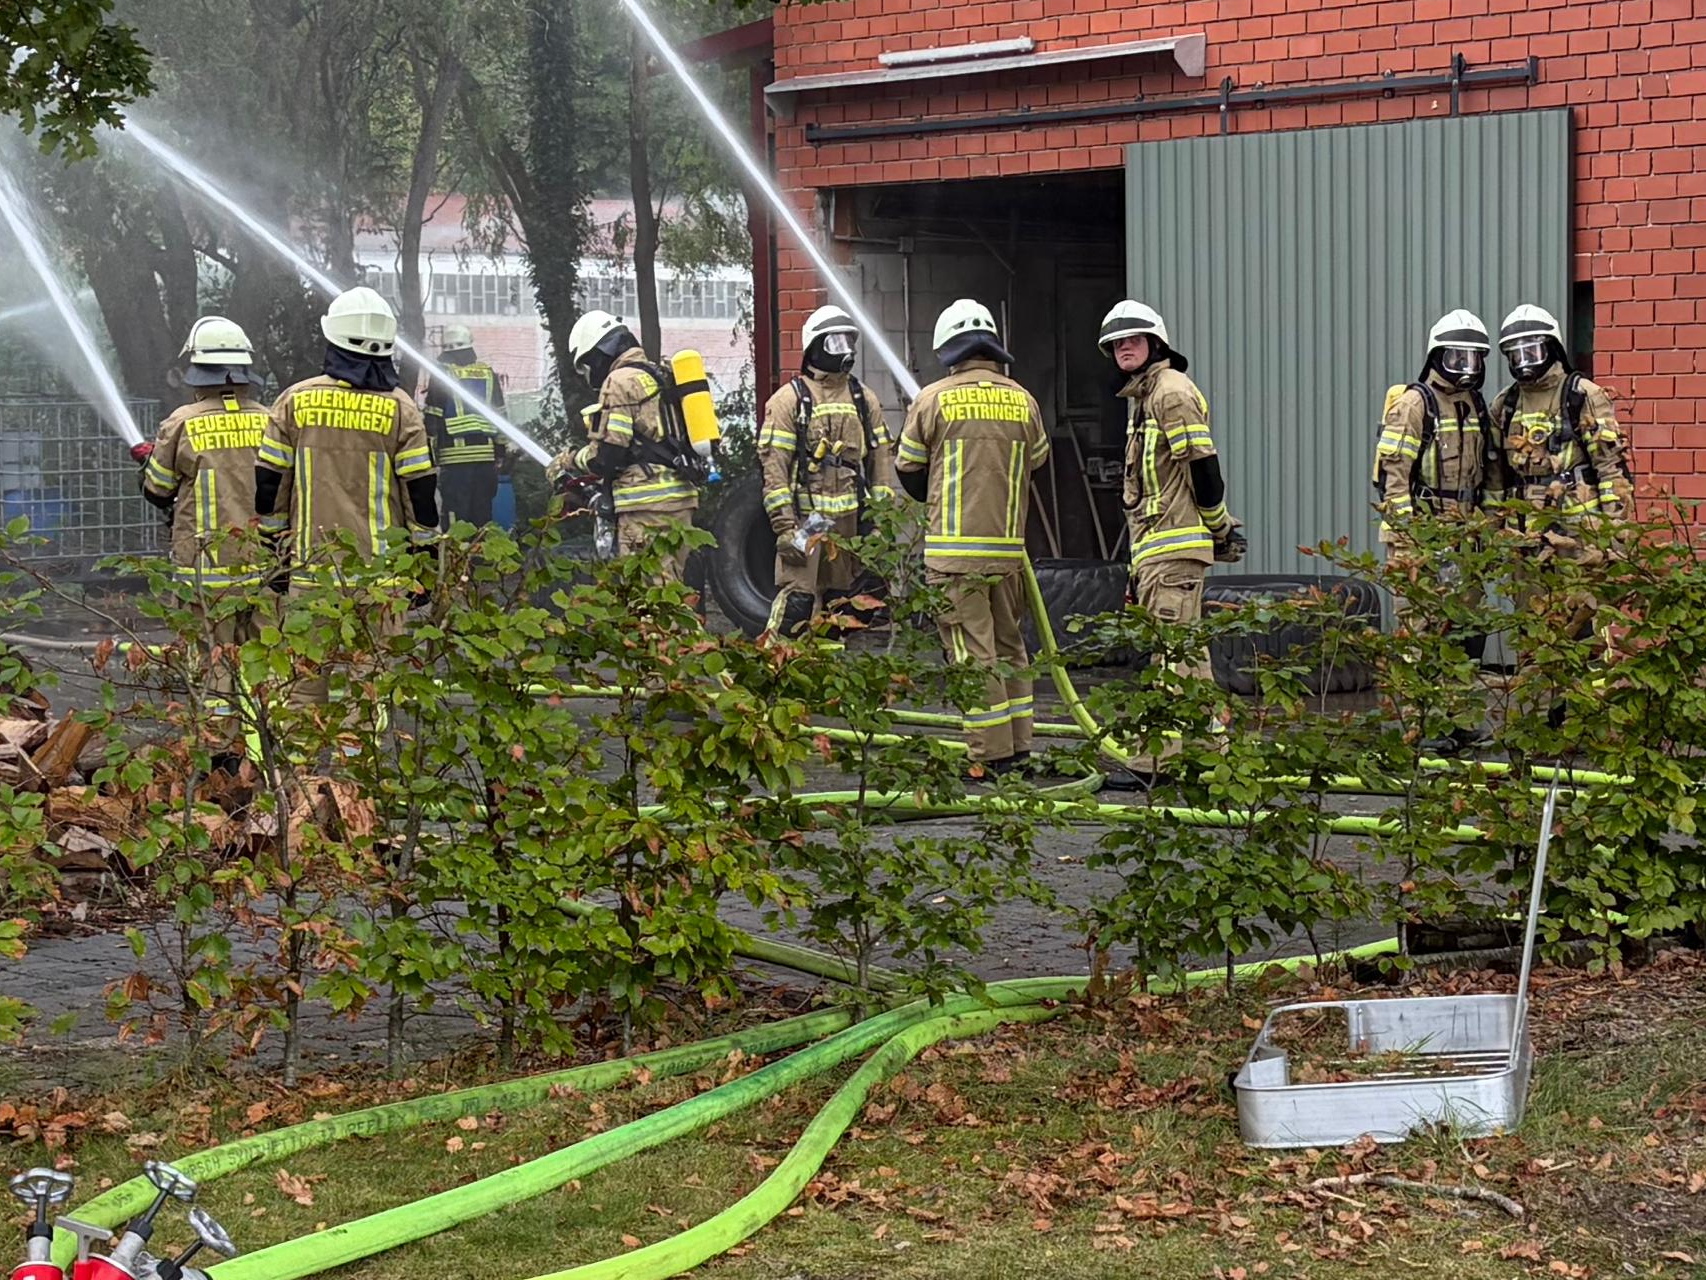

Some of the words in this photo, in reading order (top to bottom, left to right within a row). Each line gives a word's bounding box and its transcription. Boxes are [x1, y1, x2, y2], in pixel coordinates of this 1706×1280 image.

[293, 389, 396, 416] FEUERWEHR
[938, 387, 1028, 406] FEUERWEHR
[294, 407, 393, 435] WETTRINGEN
[941, 403, 1029, 423] WETTRINGEN
[185, 413, 269, 436] FEUERWEH
[189, 430, 262, 452] WETTRING
